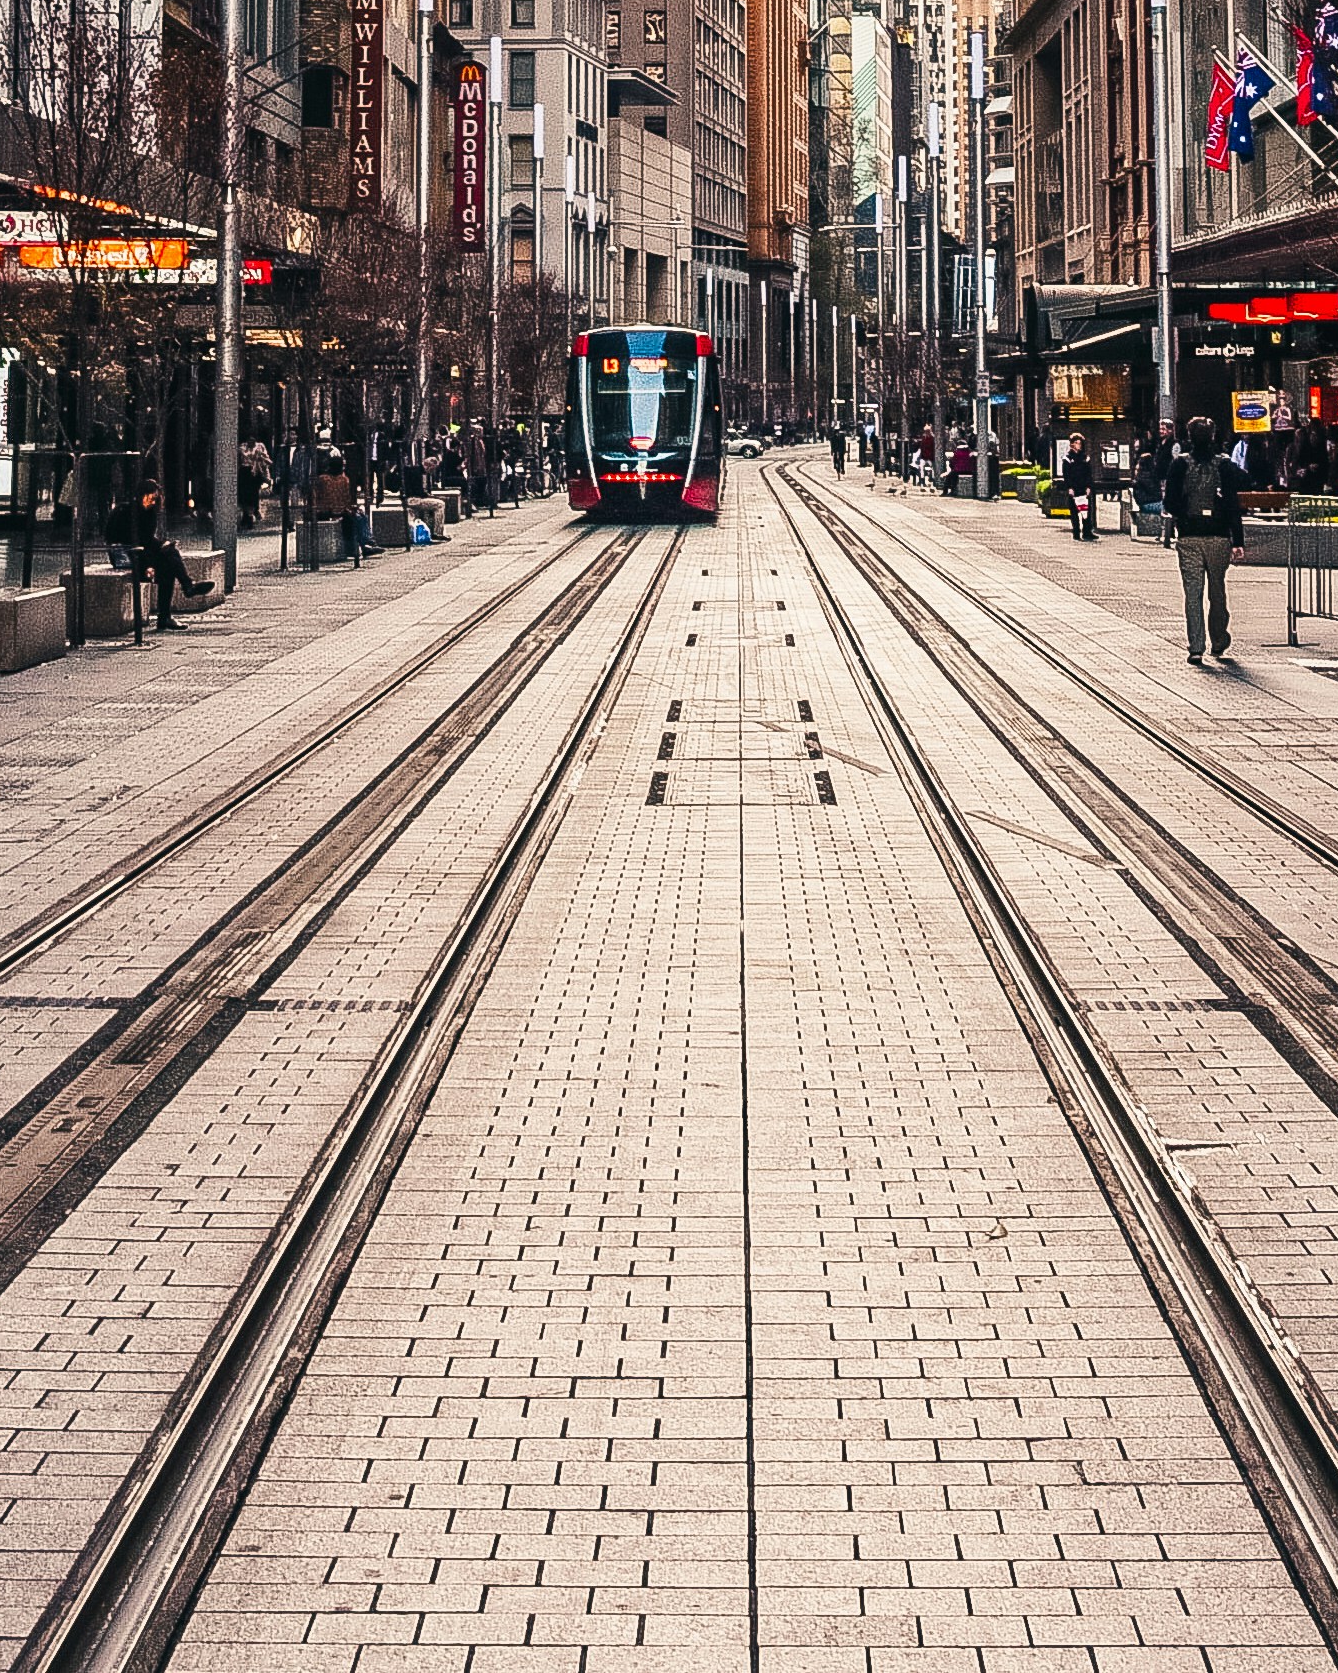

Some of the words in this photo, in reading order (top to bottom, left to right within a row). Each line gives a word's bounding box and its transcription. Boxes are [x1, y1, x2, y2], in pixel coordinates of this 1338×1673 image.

[1205, 106, 1225, 150] DYM
[458, 82, 483, 242] McDonald's
[20, 218, 55, 233] HC
[603, 357, 620, 374] L3
